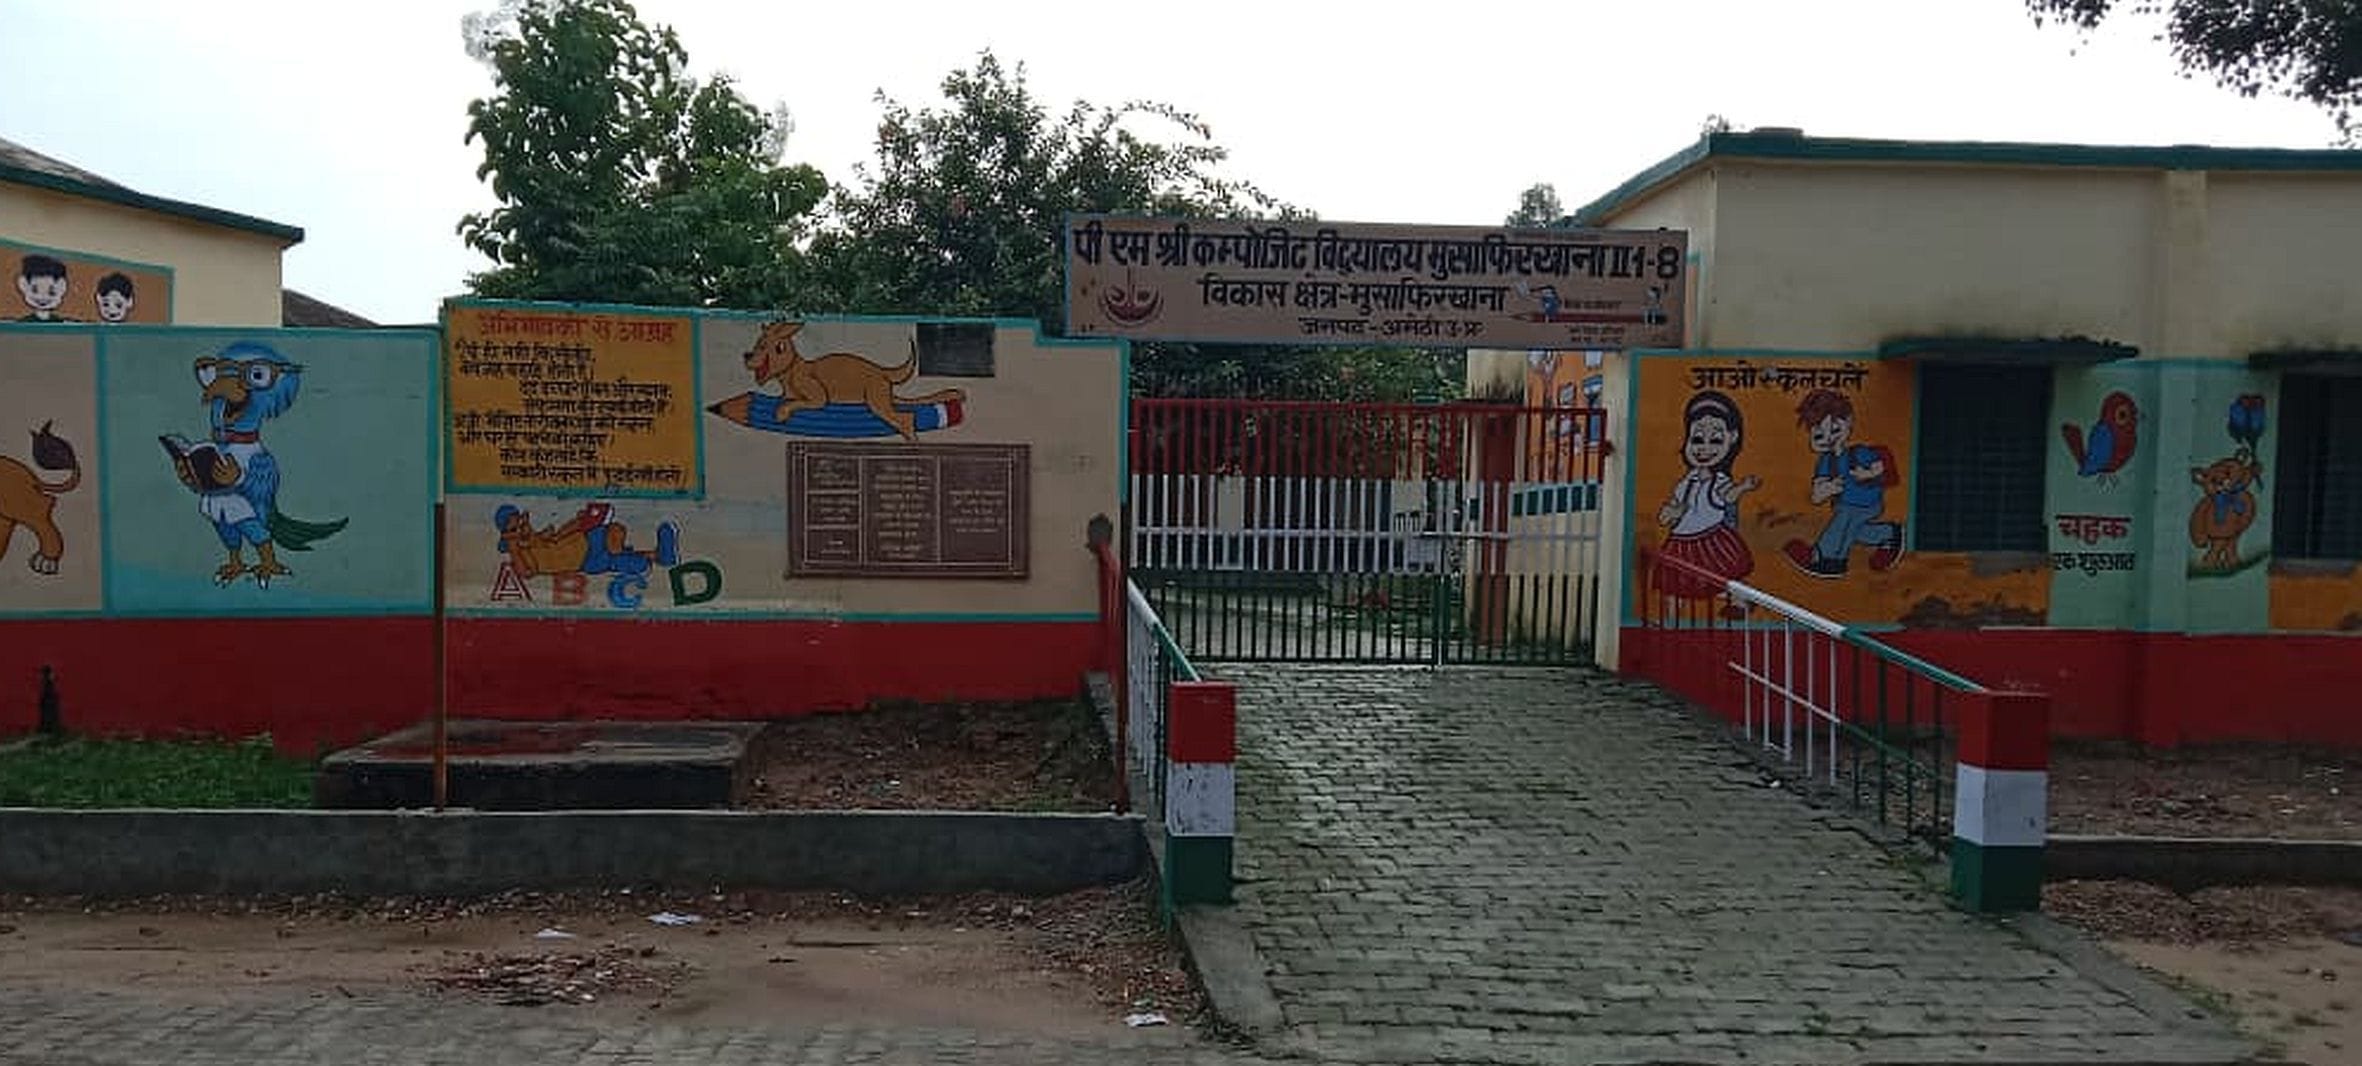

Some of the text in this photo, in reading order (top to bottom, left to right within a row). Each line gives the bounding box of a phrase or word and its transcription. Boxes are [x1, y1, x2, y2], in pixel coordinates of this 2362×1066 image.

[1074, 220, 1102, 265] पी
[1107, 231, 1154, 266] एम
[1155, 223, 1190, 267] श्री
[1197, 272, 1290, 307] विकास
[1691, 360, 1757, 390] आओ
[2055, 514, 2132, 545] चहक
[491, 560, 723, 608] A B C D
